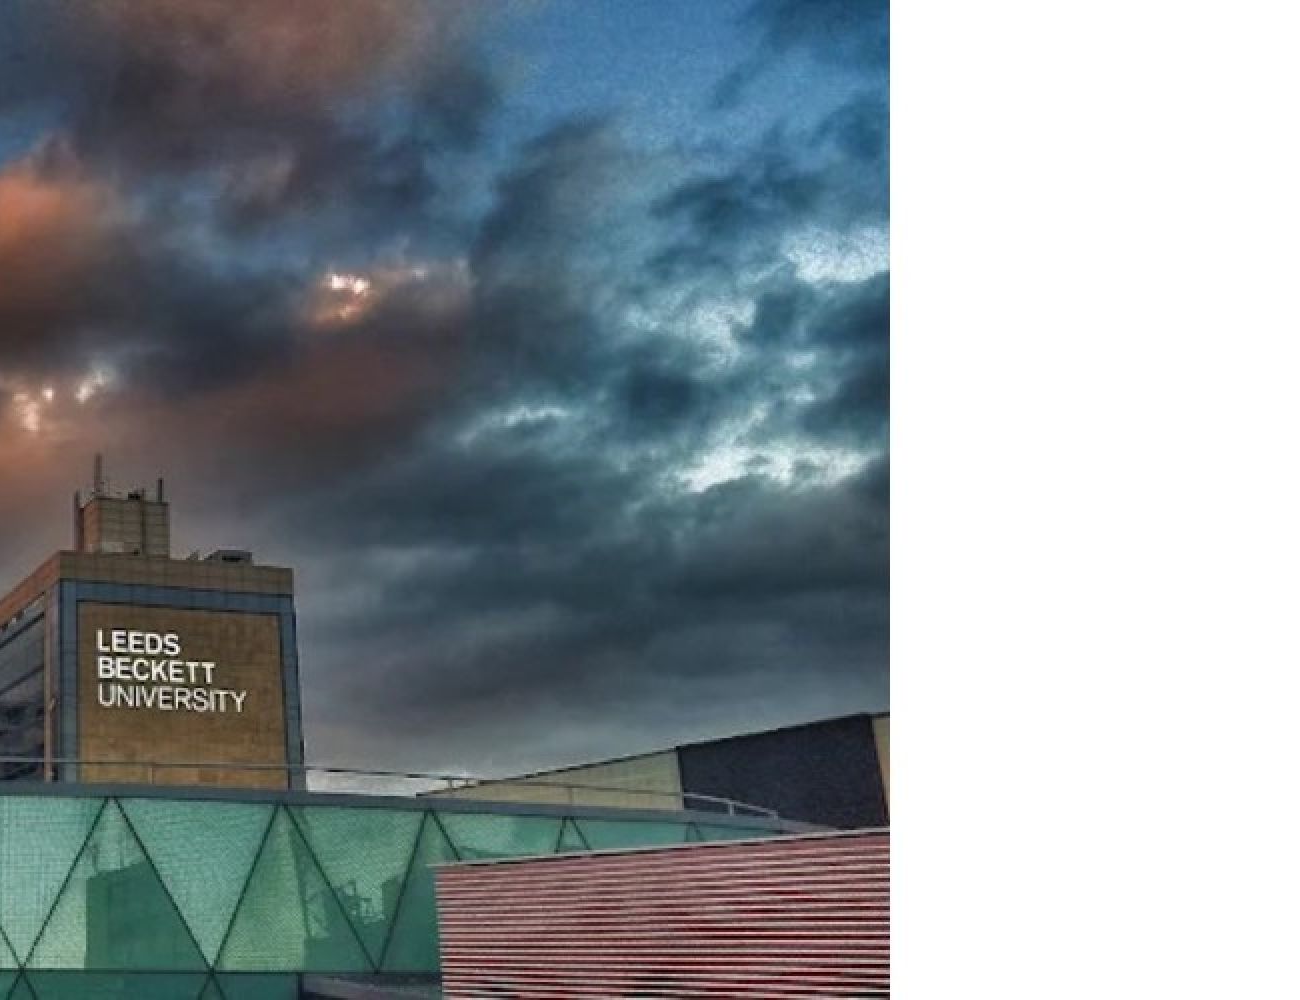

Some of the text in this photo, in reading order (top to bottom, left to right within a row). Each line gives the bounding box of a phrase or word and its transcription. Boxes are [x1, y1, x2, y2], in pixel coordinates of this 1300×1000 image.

[97, 629, 181, 655] LEEDS
[98, 656, 216, 684] BECKETT
[98, 684, 247, 712] UNIVERSITY
